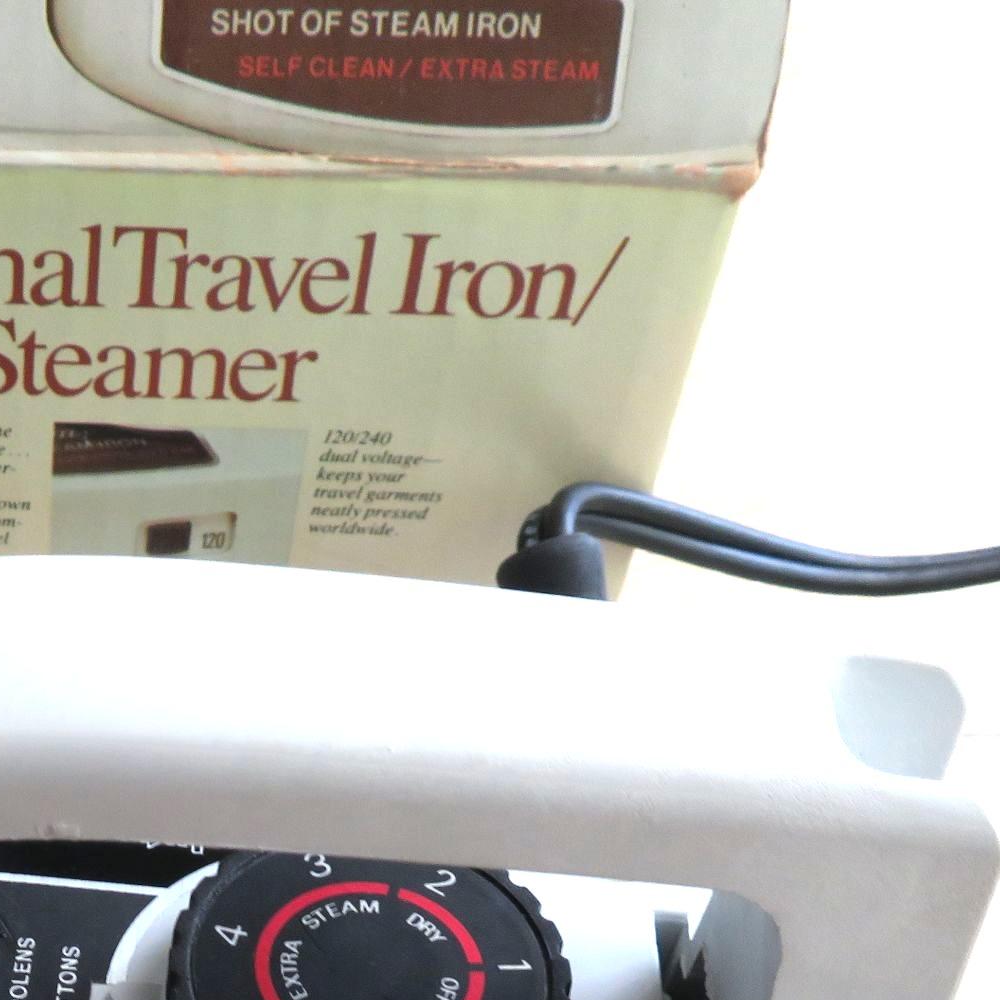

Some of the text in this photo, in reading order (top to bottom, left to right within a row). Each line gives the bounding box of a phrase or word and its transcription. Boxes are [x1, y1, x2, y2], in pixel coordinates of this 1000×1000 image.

[211, 9, 542, 38] SHOT OF STEAM IRON
[238, 55, 300, 79] SELF
[308, 56, 392, 79] CLEAN
[420, 58, 503, 80] EXTRA
[511, 61, 599, 82] STEAM
[112, 225, 377, 315] Travel
[388, 232, 631, 326] Iron/
[323, 430, 393, 445] 120/240
[319, 448, 359, 463] dual
[316, 466, 406, 486] keeps your
[313, 486, 443, 504] travel garments
[310, 504, 430, 521] neatly pressed
[202, 532, 227, 549] 120
[304, 853, 332, 878] 3
[424, 869, 457, 897] 2
[215, 923, 248, 947] 4
[405, 912, 448, 943] DRY
[279, 899, 380, 1000] EXTRA STEAM
[497, 958, 532, 971] 1
